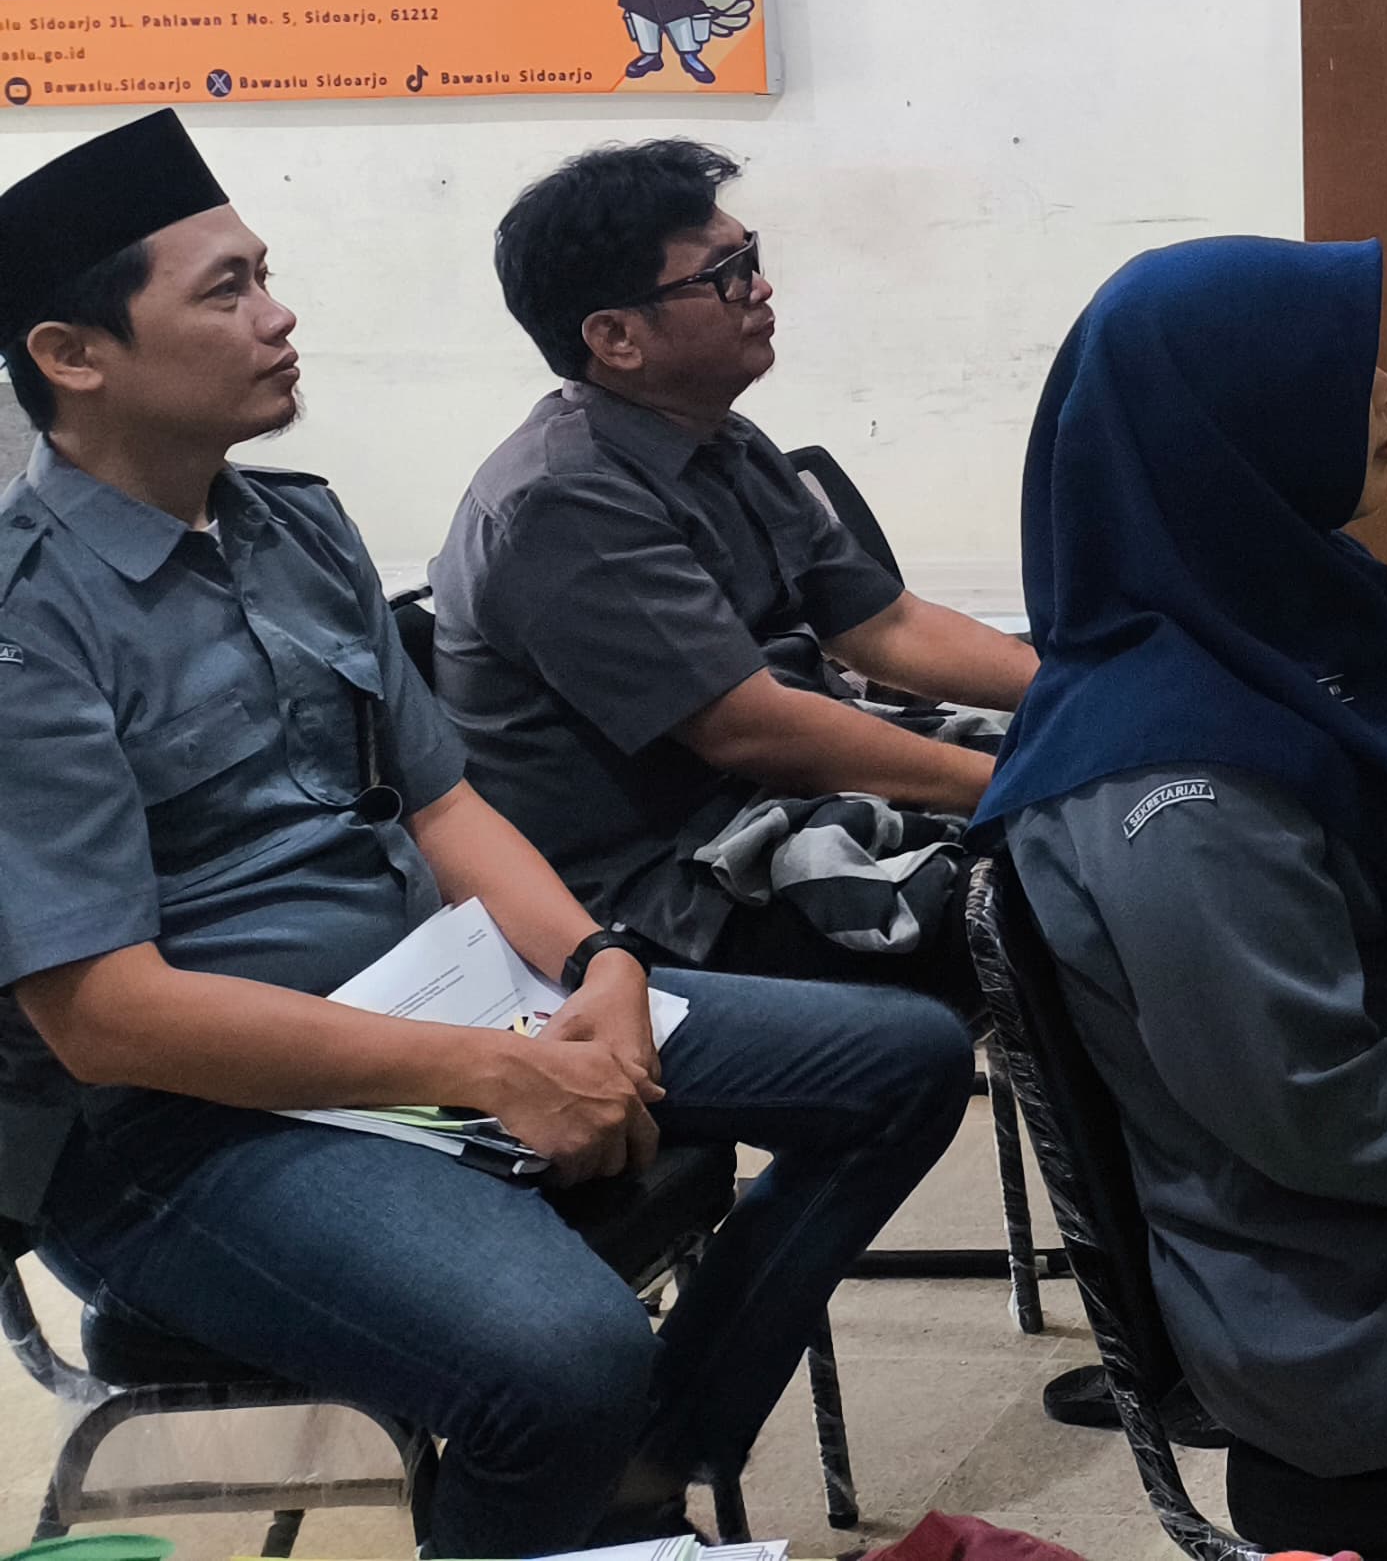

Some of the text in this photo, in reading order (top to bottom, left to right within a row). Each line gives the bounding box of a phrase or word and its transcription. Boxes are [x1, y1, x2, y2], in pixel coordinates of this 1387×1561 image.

[30, 17, 101, 32] Sidoarjo
[142, 14, 222, 28] Pahlawan
[231, 14, 238, 25] I
[247, 13, 273, 26] No.
[305, 10, 382, 26] Sidoarjo,
[390, 8, 439, 21] 61212
[240, 74, 387, 90] Bawaslu Sidoarjo
[441, 68, 592, 85] Bawaslu Sidoarjo
[1129, 783, 1206, 828] SEKRETARIAT
